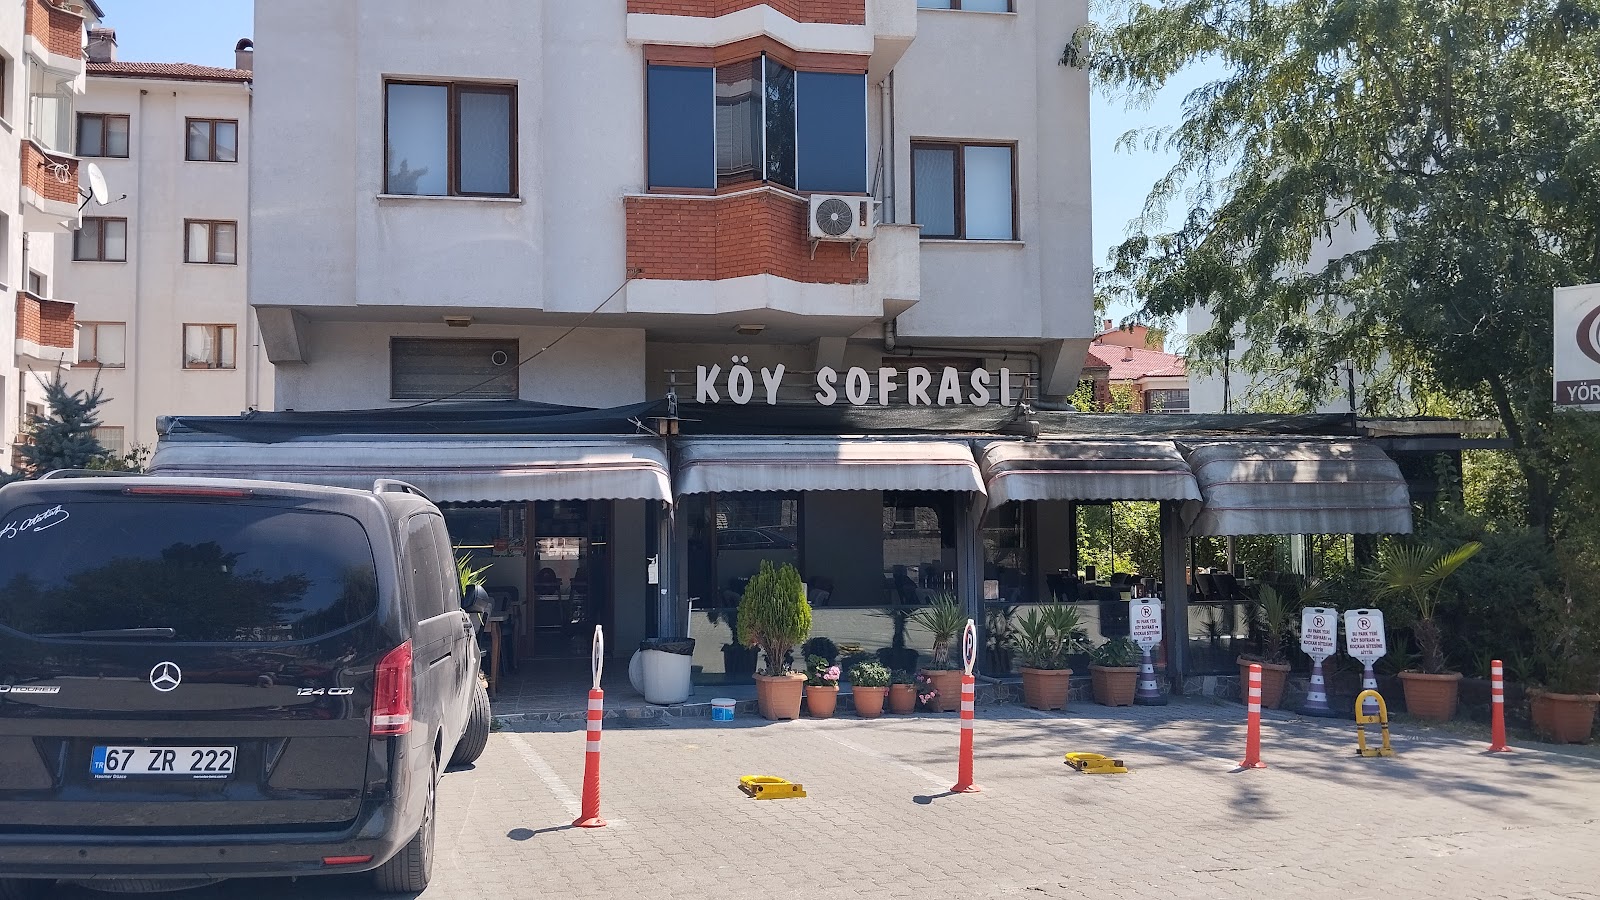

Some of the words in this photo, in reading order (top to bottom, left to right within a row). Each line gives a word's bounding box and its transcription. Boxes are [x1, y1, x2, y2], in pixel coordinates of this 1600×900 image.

[696, 355, 785, 405] KÖY
[815, 366, 1010, 407] SOFRASI
[1567, 382, 1600, 402] YÖR
[297, 687, 325, 696] 124
[94, 761, 104, 769] TR
[106, 749, 135, 771] 67
[148, 750, 176, 771] ZR
[190, 750, 232, 771] 222
